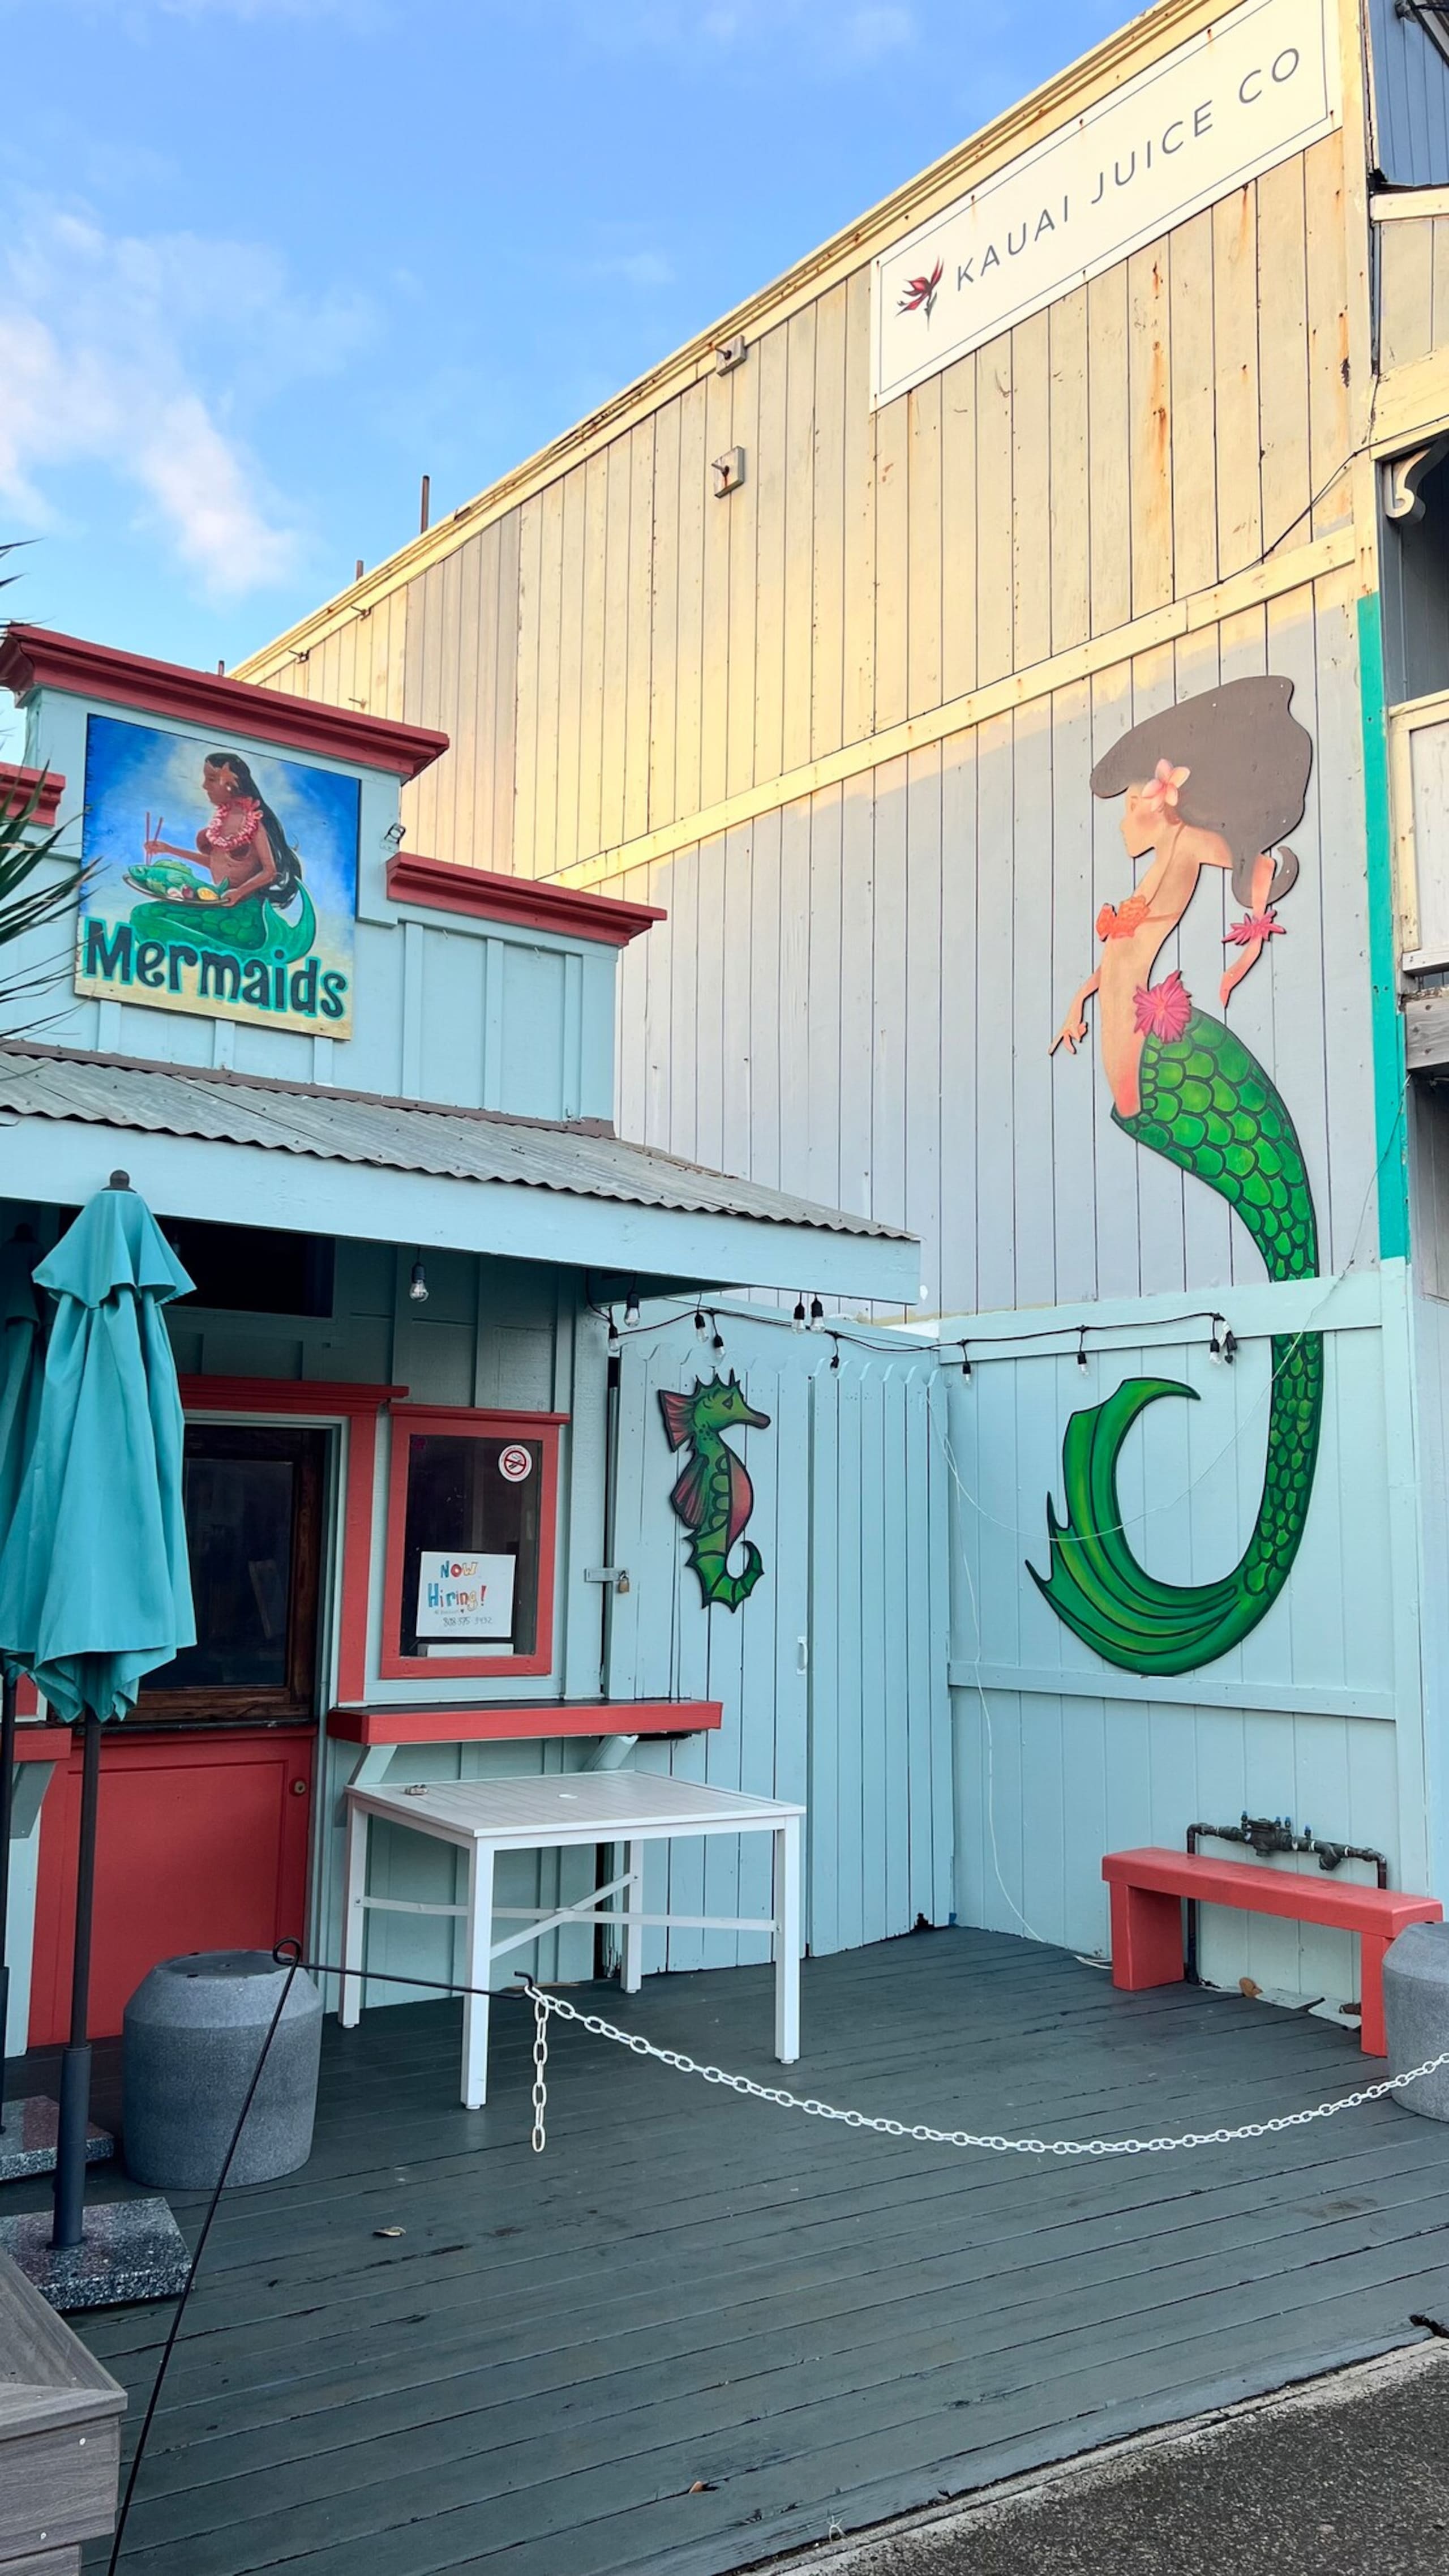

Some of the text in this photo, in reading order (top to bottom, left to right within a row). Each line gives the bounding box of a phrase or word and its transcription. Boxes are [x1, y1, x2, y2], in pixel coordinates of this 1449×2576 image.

[957, 48, 1301, 292] KAUAI JUICE CO
[83, 916, 348, 1019] Mermaids
[428, 1583, 487, 1611] Hiring!
